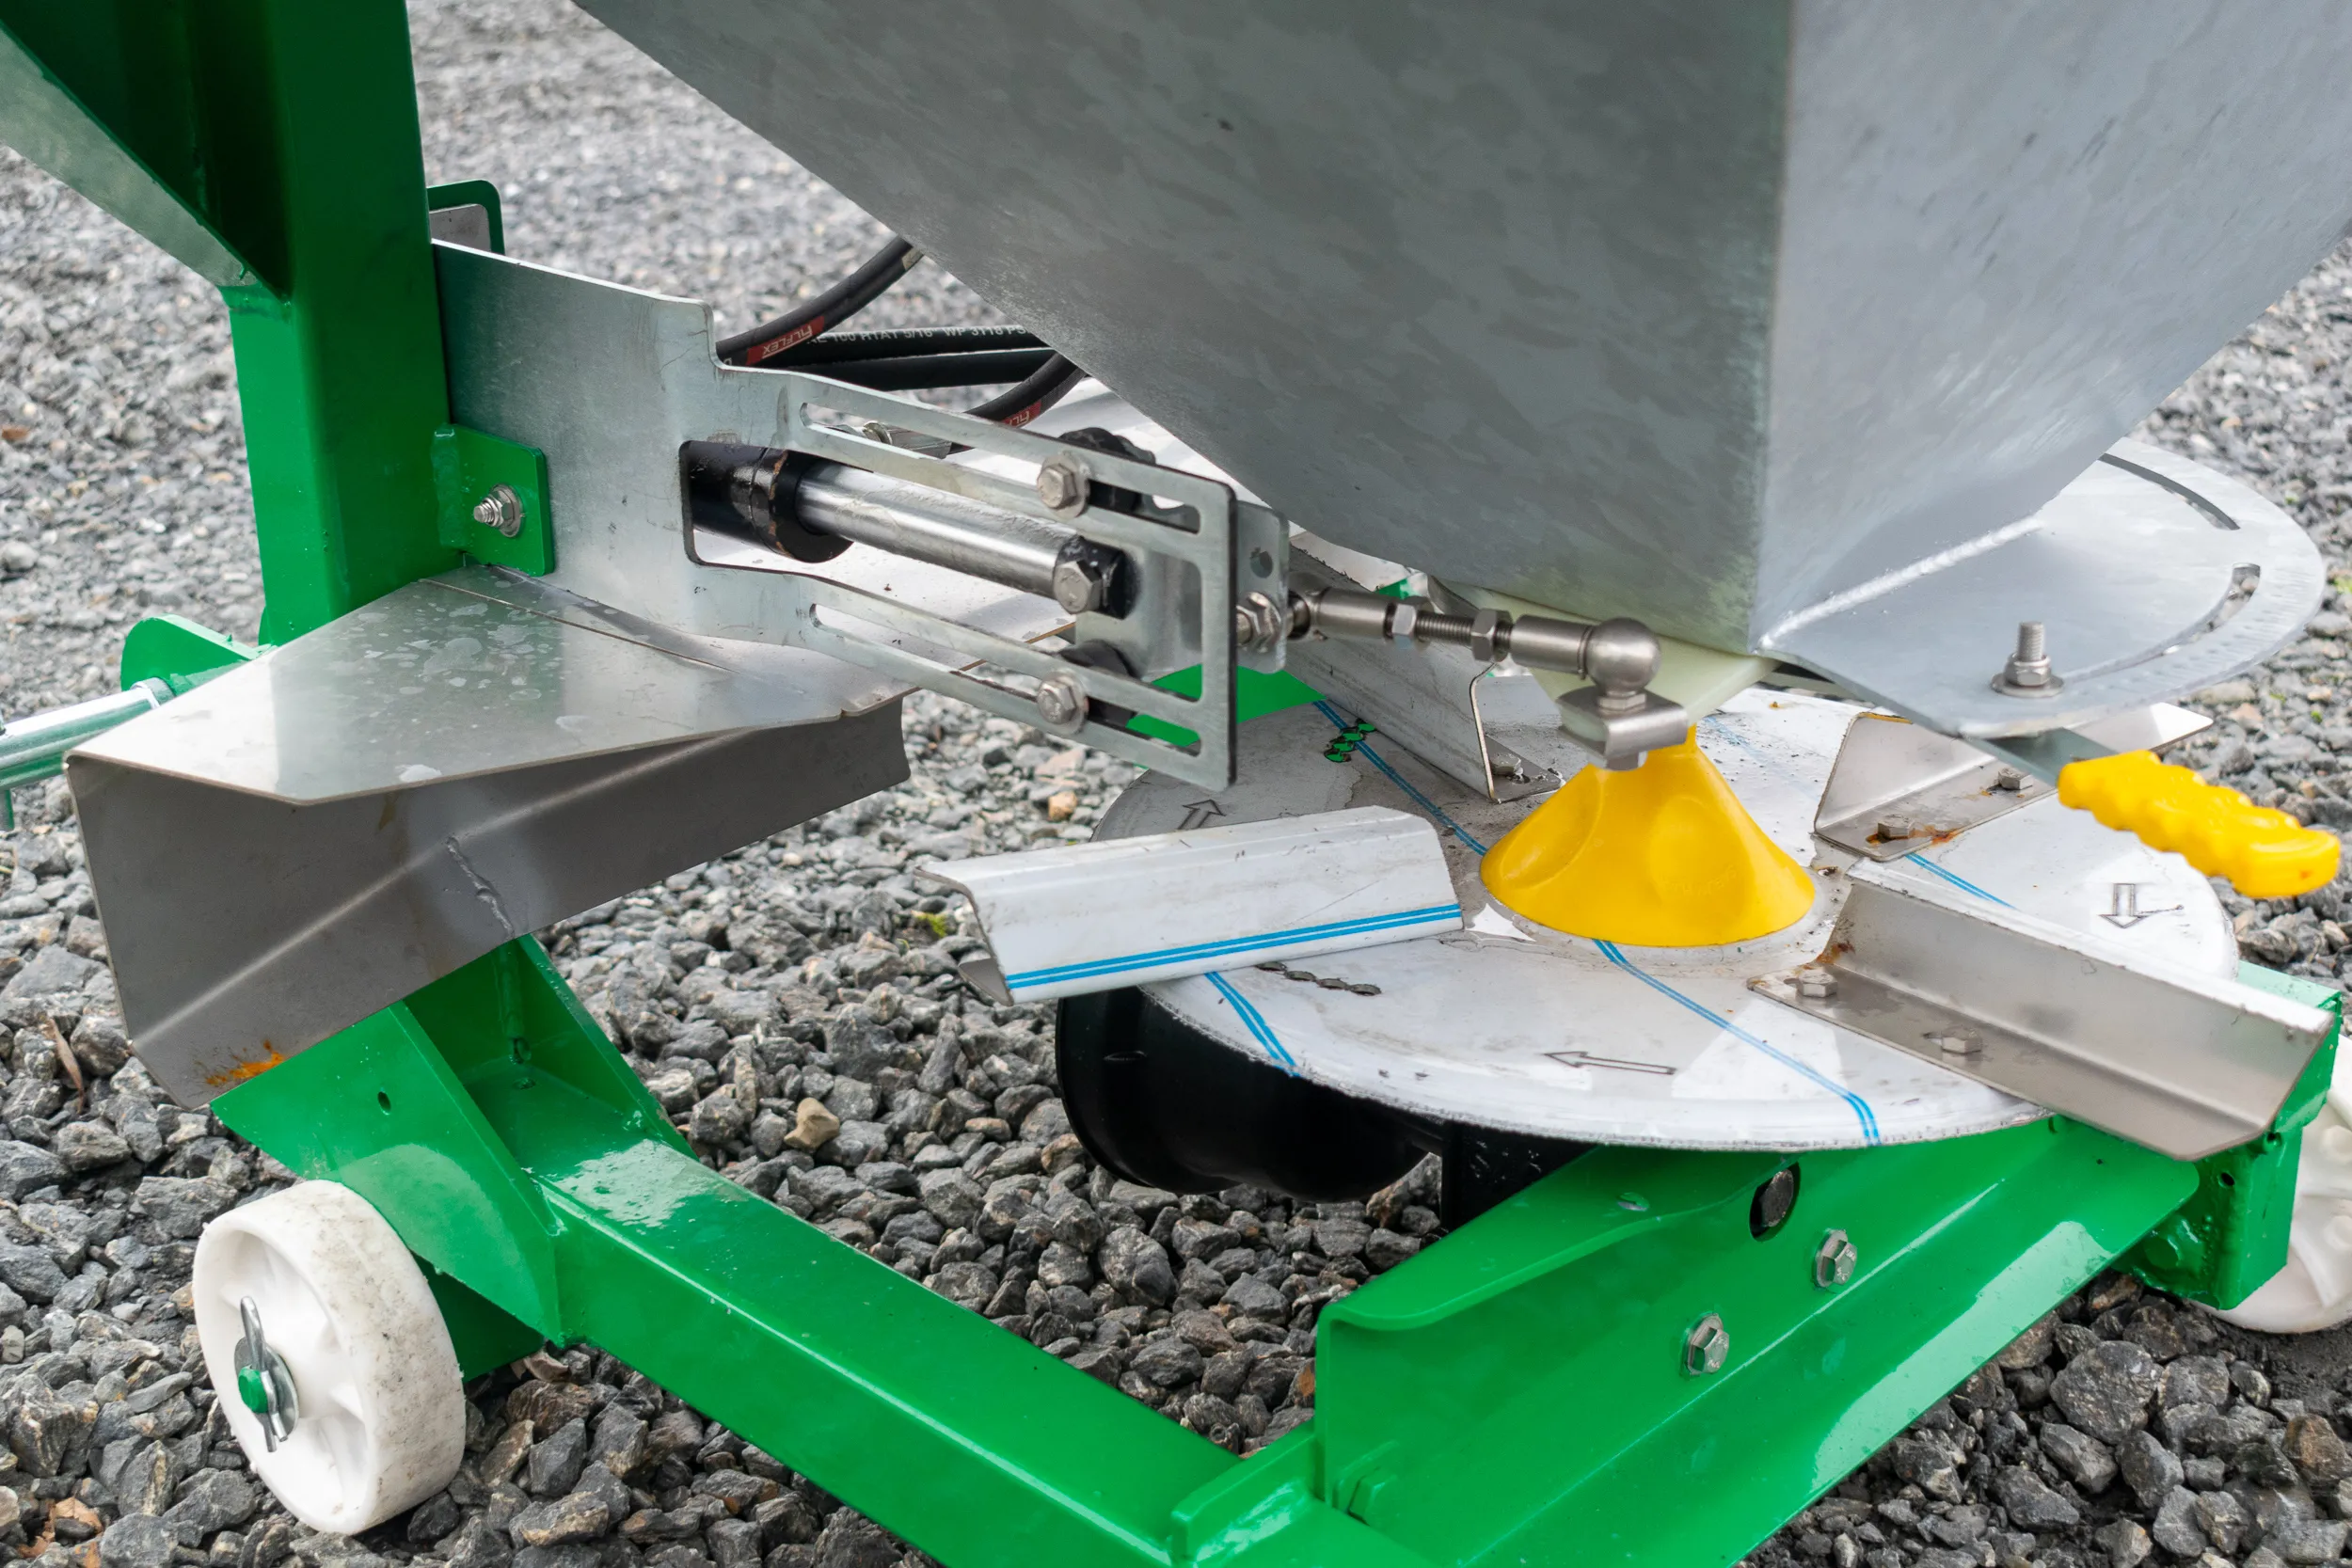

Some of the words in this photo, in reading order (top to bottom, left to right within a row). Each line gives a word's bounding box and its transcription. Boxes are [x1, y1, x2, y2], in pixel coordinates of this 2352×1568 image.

[943, 326, 967, 337] WP
[970, 325, 1003, 336] 3118
[1006, 325, 1031, 335] PS
